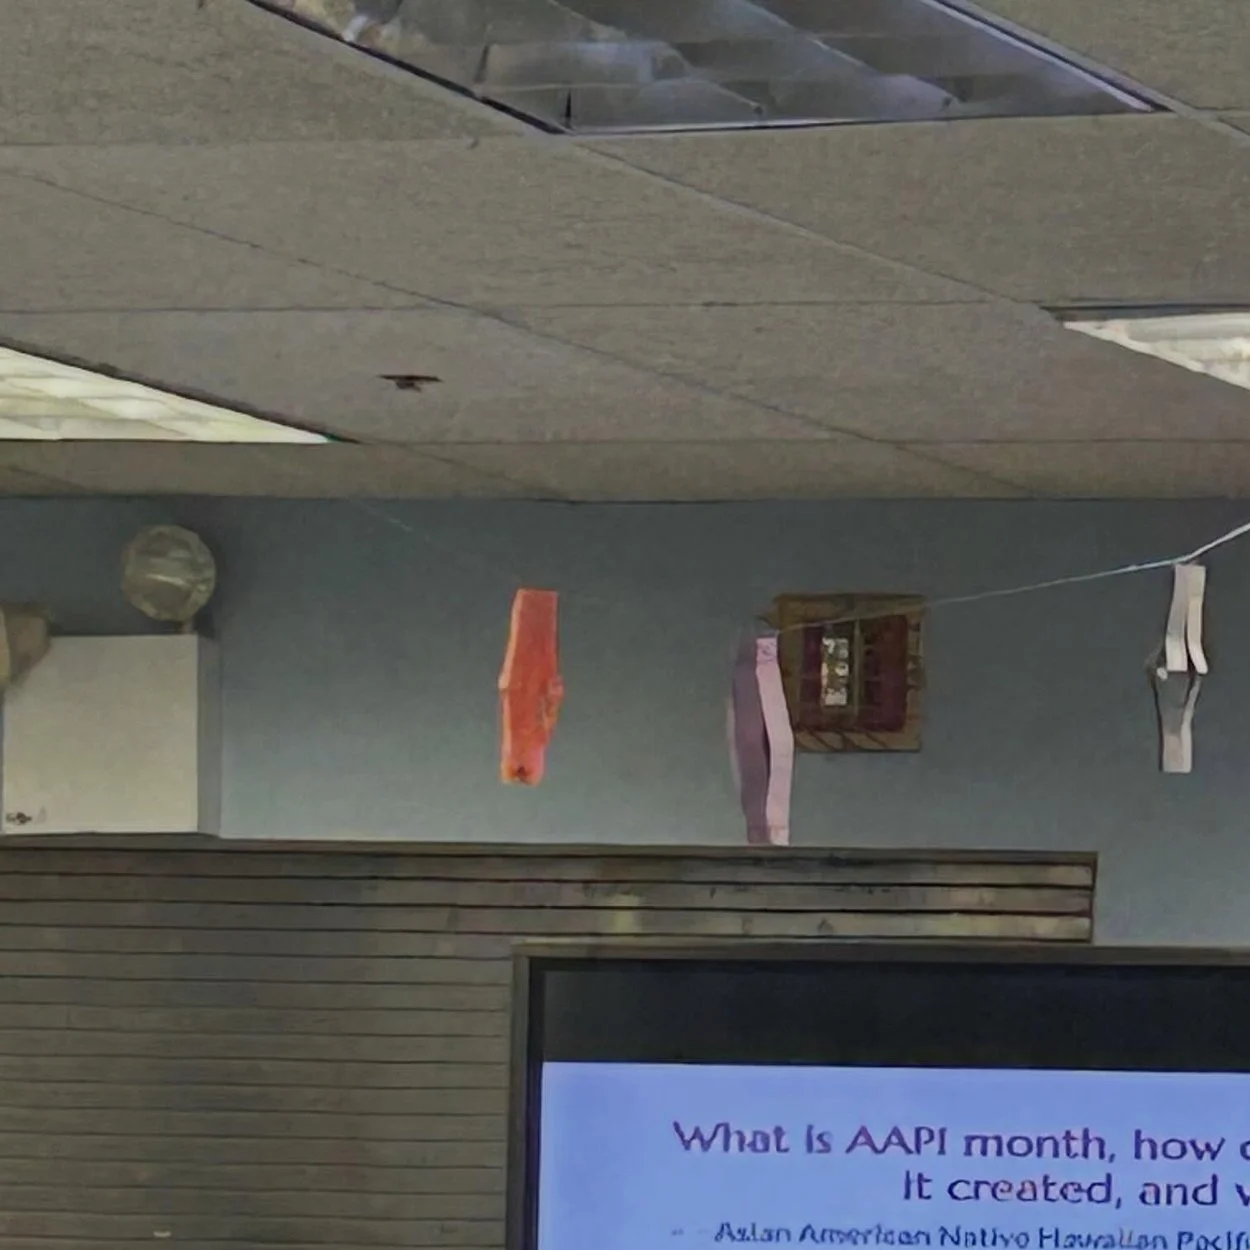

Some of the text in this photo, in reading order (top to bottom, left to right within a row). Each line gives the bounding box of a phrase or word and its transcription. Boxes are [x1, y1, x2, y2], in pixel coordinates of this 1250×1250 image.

[673, 1121, 790, 1153] What
[806, 1124, 831, 1154] is
[845, 1125, 947, 1156] AAPI
[963, 1127, 1116, 1163] month,
[1134, 1129, 1225, 1161] how
[948, 1173, 1121, 1209] created,
[1139, 1174, 1218, 1207] and
[714, 1222, 791, 1244] Asian
[799, 1223, 930, 1247] American
[939, 1225, 1029, 1249] Native
